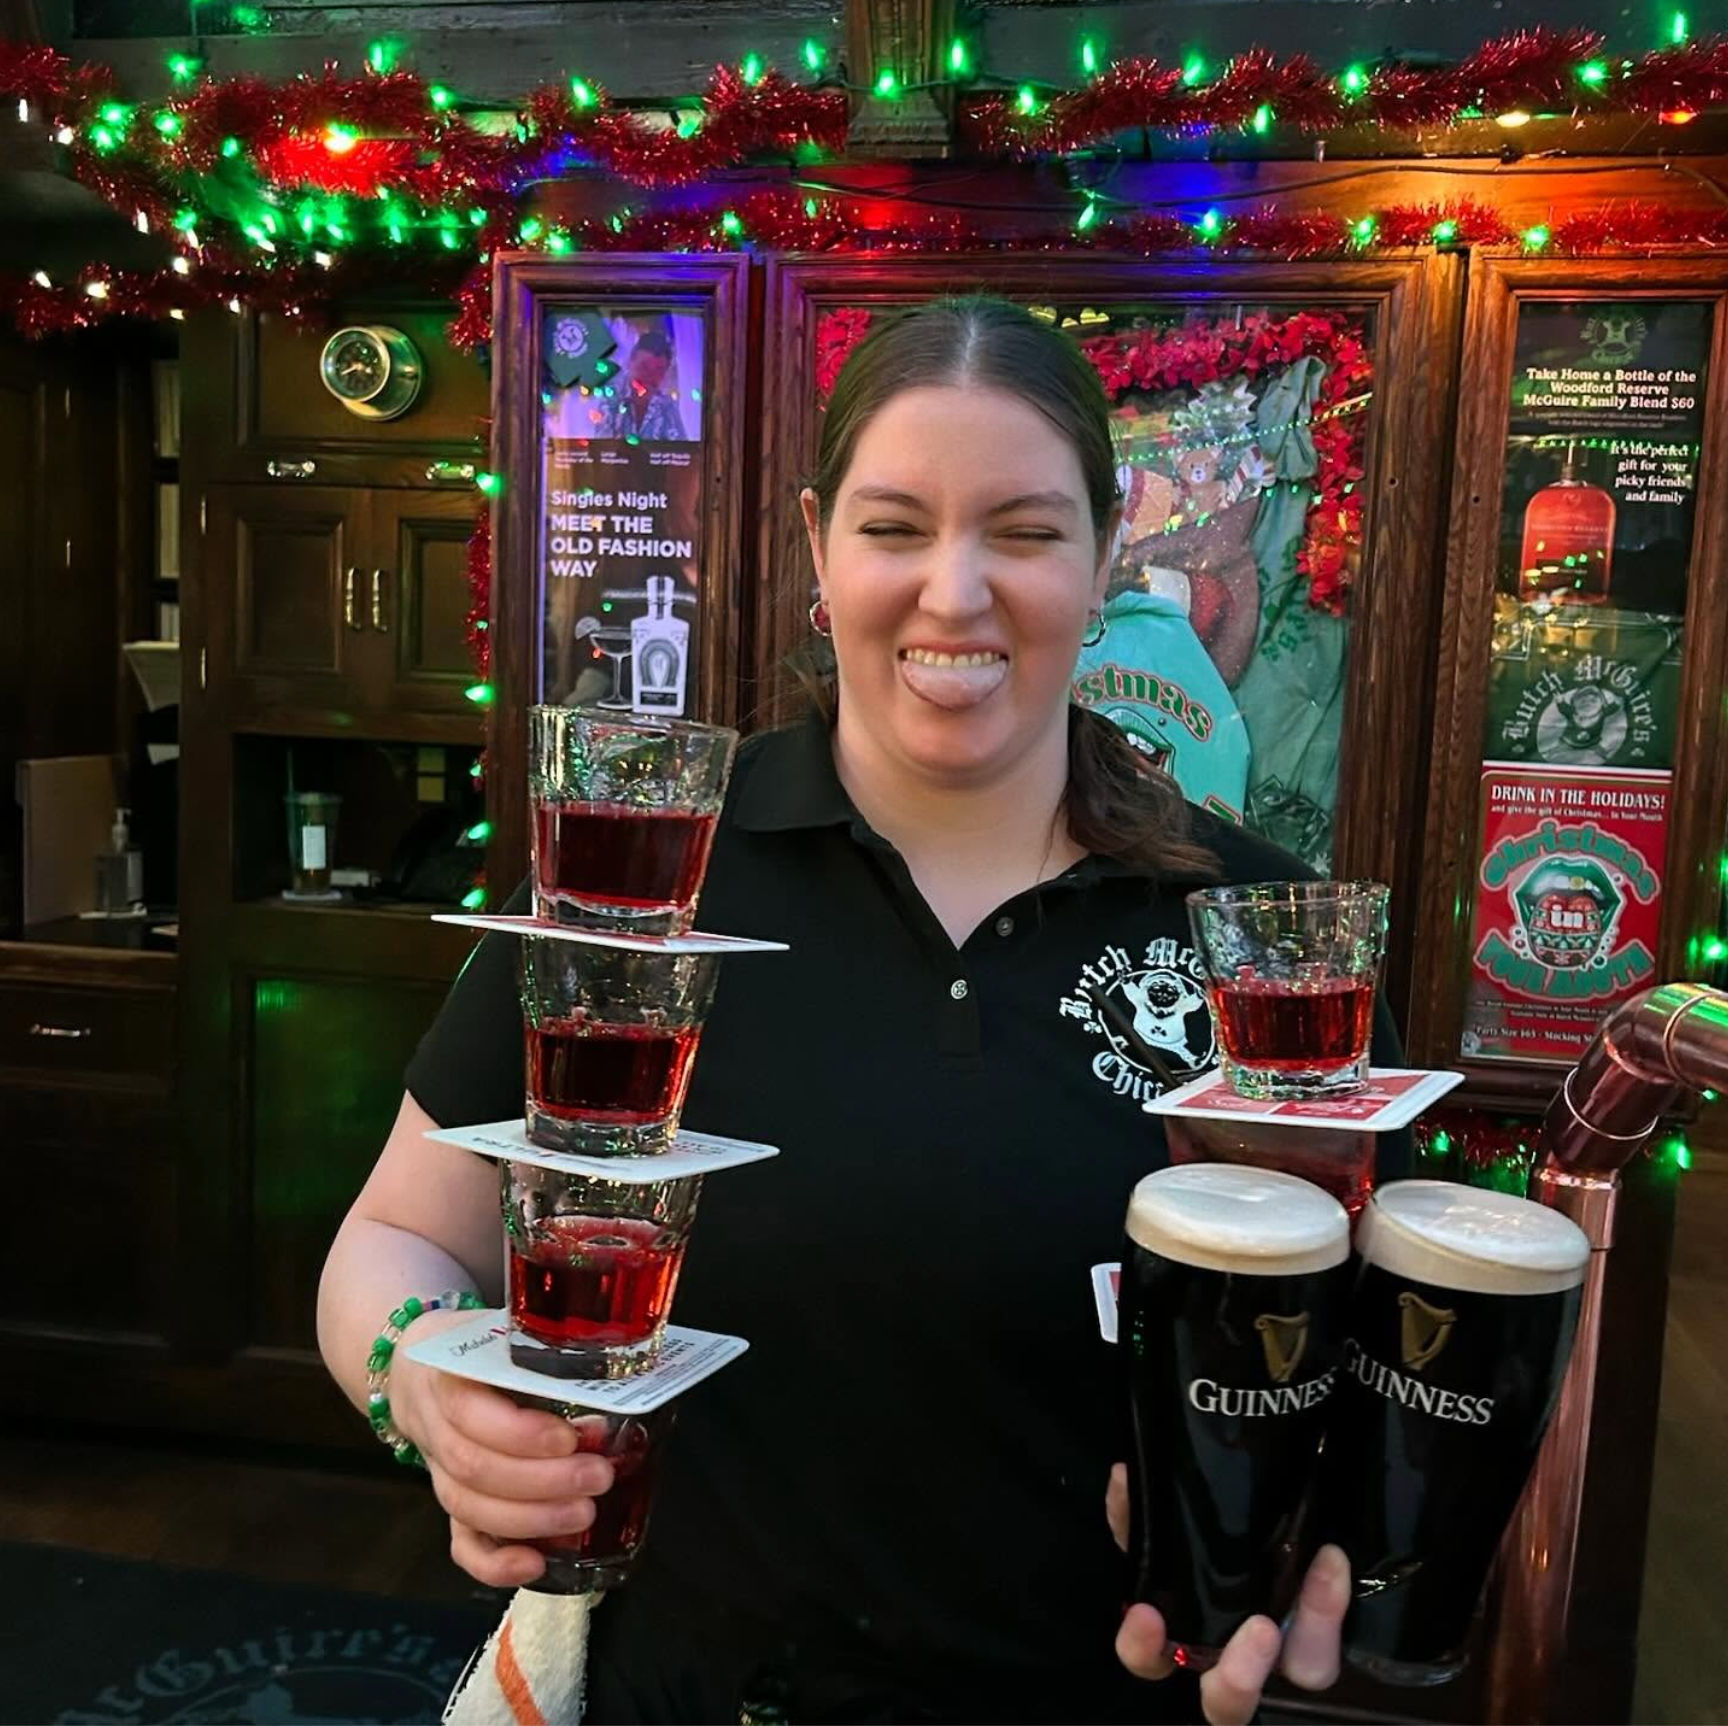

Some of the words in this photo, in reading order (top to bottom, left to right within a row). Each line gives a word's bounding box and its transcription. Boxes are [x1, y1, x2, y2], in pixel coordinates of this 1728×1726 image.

[1526, 368, 1558, 380] Take
[1561, 368, 1600, 380] Home
[1603, 371, 1611, 380] a
[1615, 370, 1654, 381] Bottle
[1657, 371, 1673, 382] of
[1675, 371, 1697, 382] the
[1550, 382, 1613, 394] Woodford
[1617, 384, 1669, 395] Reserve
[1523, 394, 1579, 406] McGuire
[1582, 395, 1627, 410] Family
[1630, 396, 1668, 408] Blend
[1671, 398, 1695, 409] $60
[1618, 460, 1637, 472] gift
[1640, 460, 1657, 471] for
[1662, 463, 1688, 473] your
[1615, 475, 1646, 488] picky
[1648, 475, 1686, 487] friends
[551, 490, 613, 509] Singles
[618, 491, 668, 510] Night
[1625, 490, 1646, 502] and
[1649, 491, 1685, 505] family
[551, 514, 606, 532] MEET
[611, 516, 653, 533] THE
[551, 537, 593, 554] OLD
[598, 538, 692, 558] FASHION
[551, 560, 597, 577] WAY
[1073, 665, 1212, 742] stmas
[1491, 784, 1536, 802] DRINK
[1540, 787, 1555, 803] IN
[1560, 788, 1586, 805] THE
[1591, 790, 1665, 810] HOLIDAYS!
[1551, 905, 1583, 927] in
[1059, 944, 1132, 1019] Butch
[1345, 1337, 1495, 1425] GUINNESS
